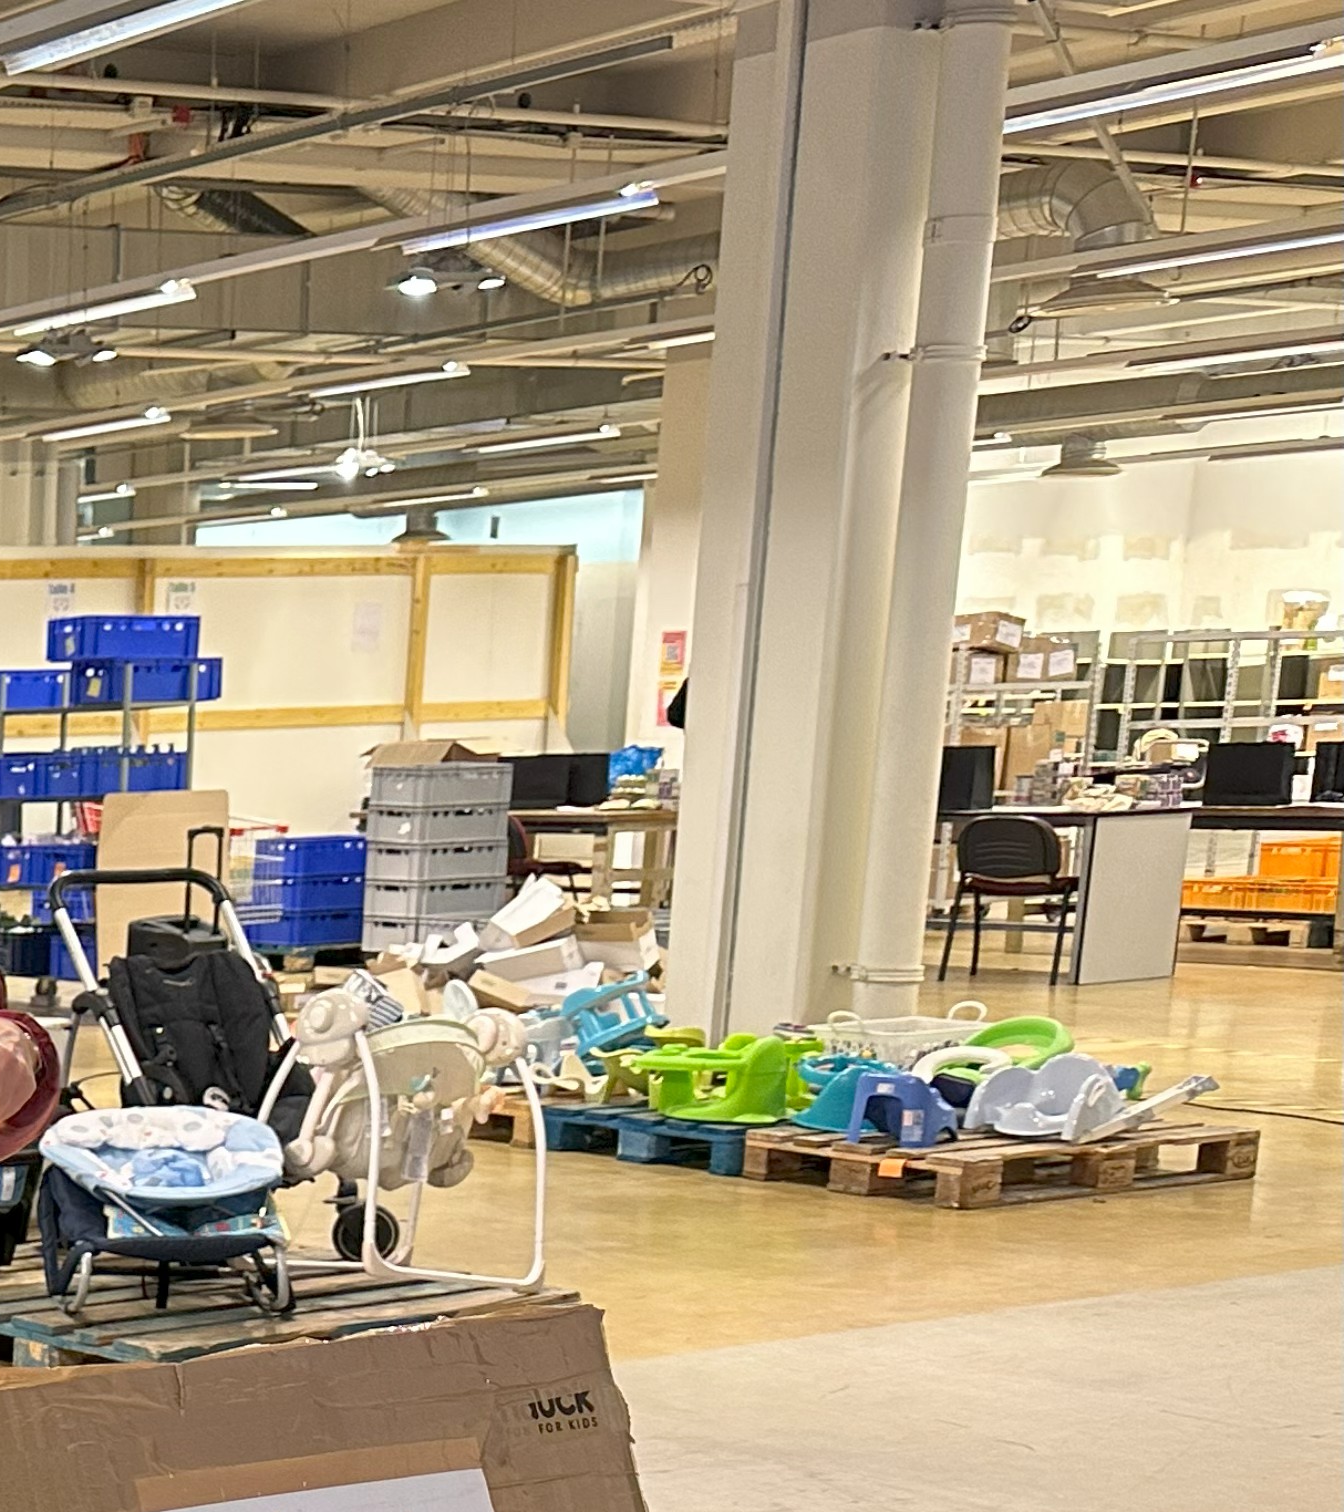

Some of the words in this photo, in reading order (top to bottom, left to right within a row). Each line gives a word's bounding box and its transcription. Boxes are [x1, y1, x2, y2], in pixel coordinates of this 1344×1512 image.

[528, 1390, 595, 1420] UCK
[538, 1421, 563, 1434] FOR
[568, 1416, 599, 1430] KIDS
